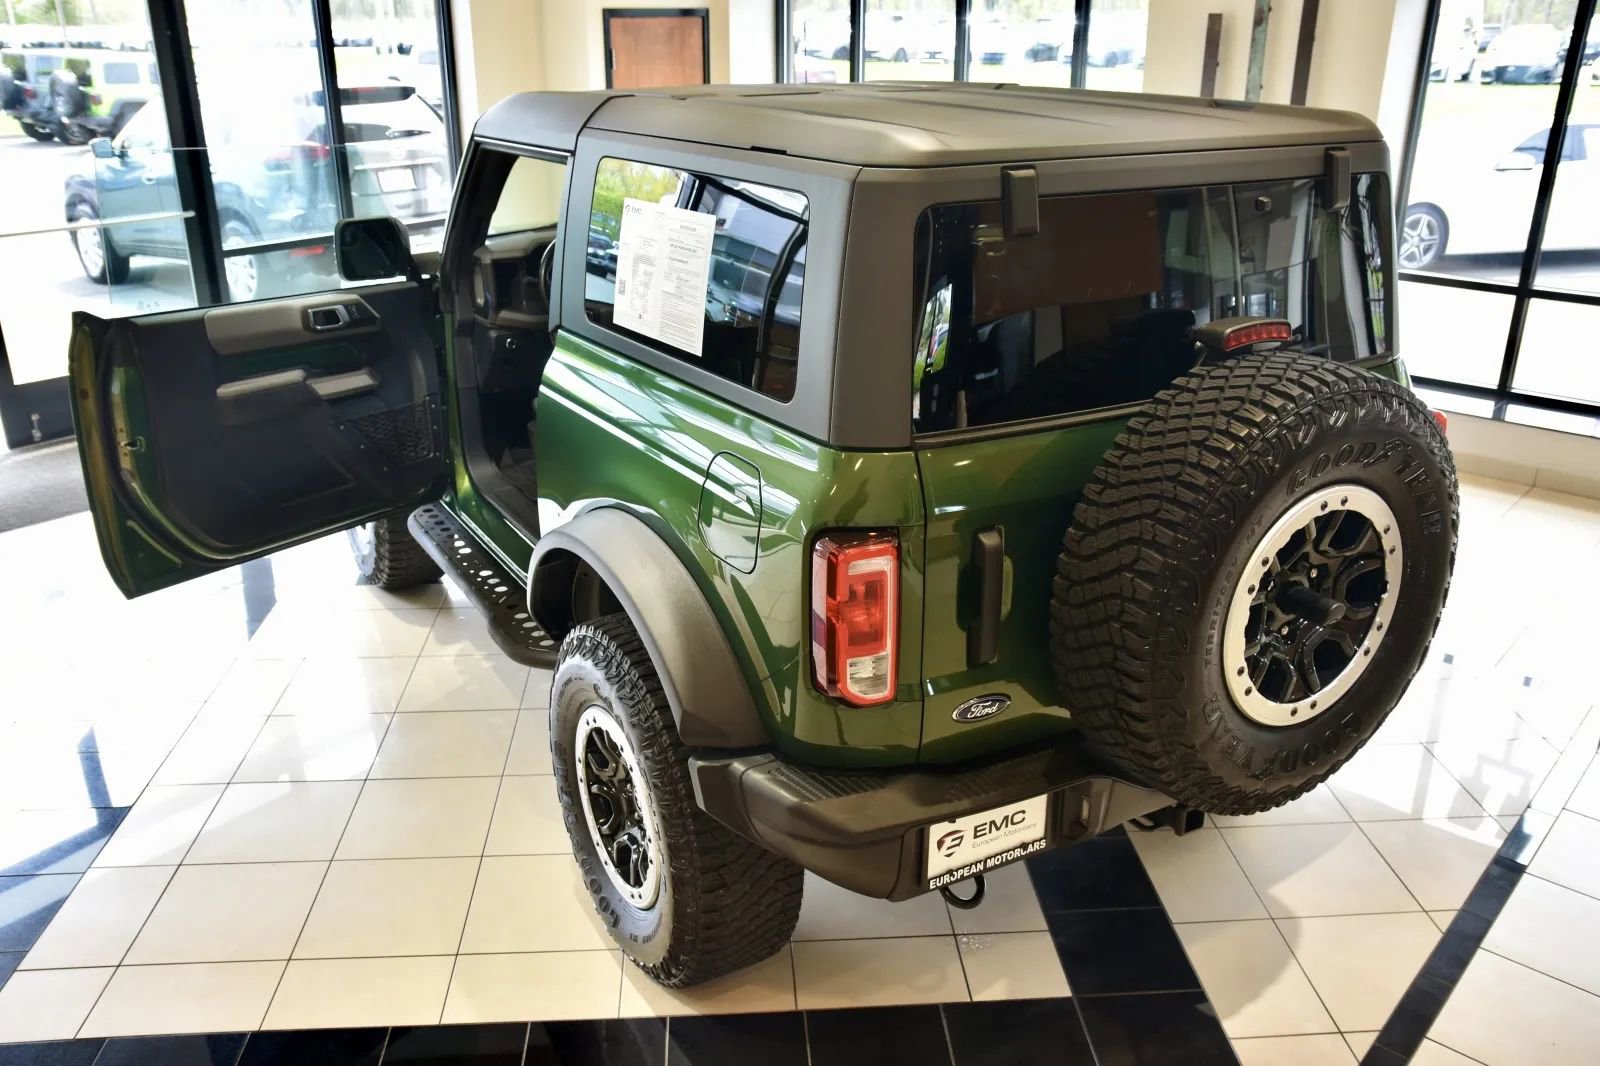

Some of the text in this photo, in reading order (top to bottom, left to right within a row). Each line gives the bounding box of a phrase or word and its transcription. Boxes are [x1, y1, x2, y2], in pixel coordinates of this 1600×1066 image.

[1286, 439, 1442, 534] GOODYEAR
[967, 700, 999, 719] Ford
[973, 809, 1026, 839] EMC
[929, 839, 1047, 889] EUROPEAN MOTORCARS
